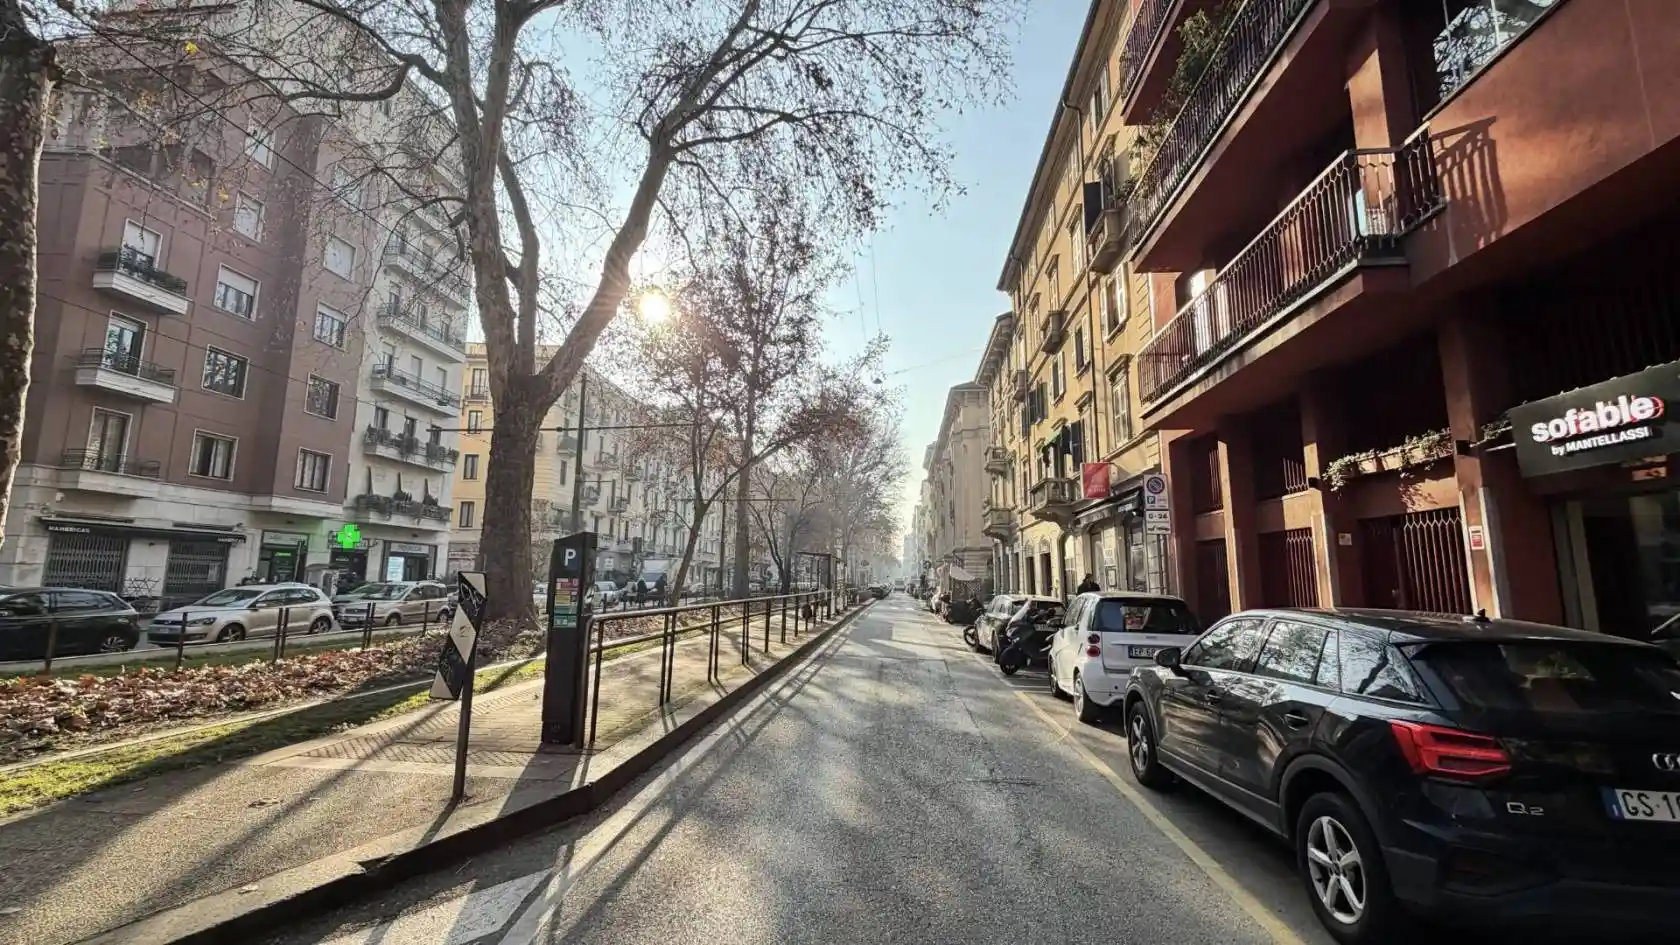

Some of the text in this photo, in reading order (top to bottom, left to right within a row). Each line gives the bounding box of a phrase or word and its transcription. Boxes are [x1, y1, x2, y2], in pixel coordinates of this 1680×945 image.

[1531, 395, 1656, 442] sofable
[1551, 427, 1650, 456] by MANTELLASSI
[564, 548, 576, 566] P
[1506, 802, 1545, 816] Q2
